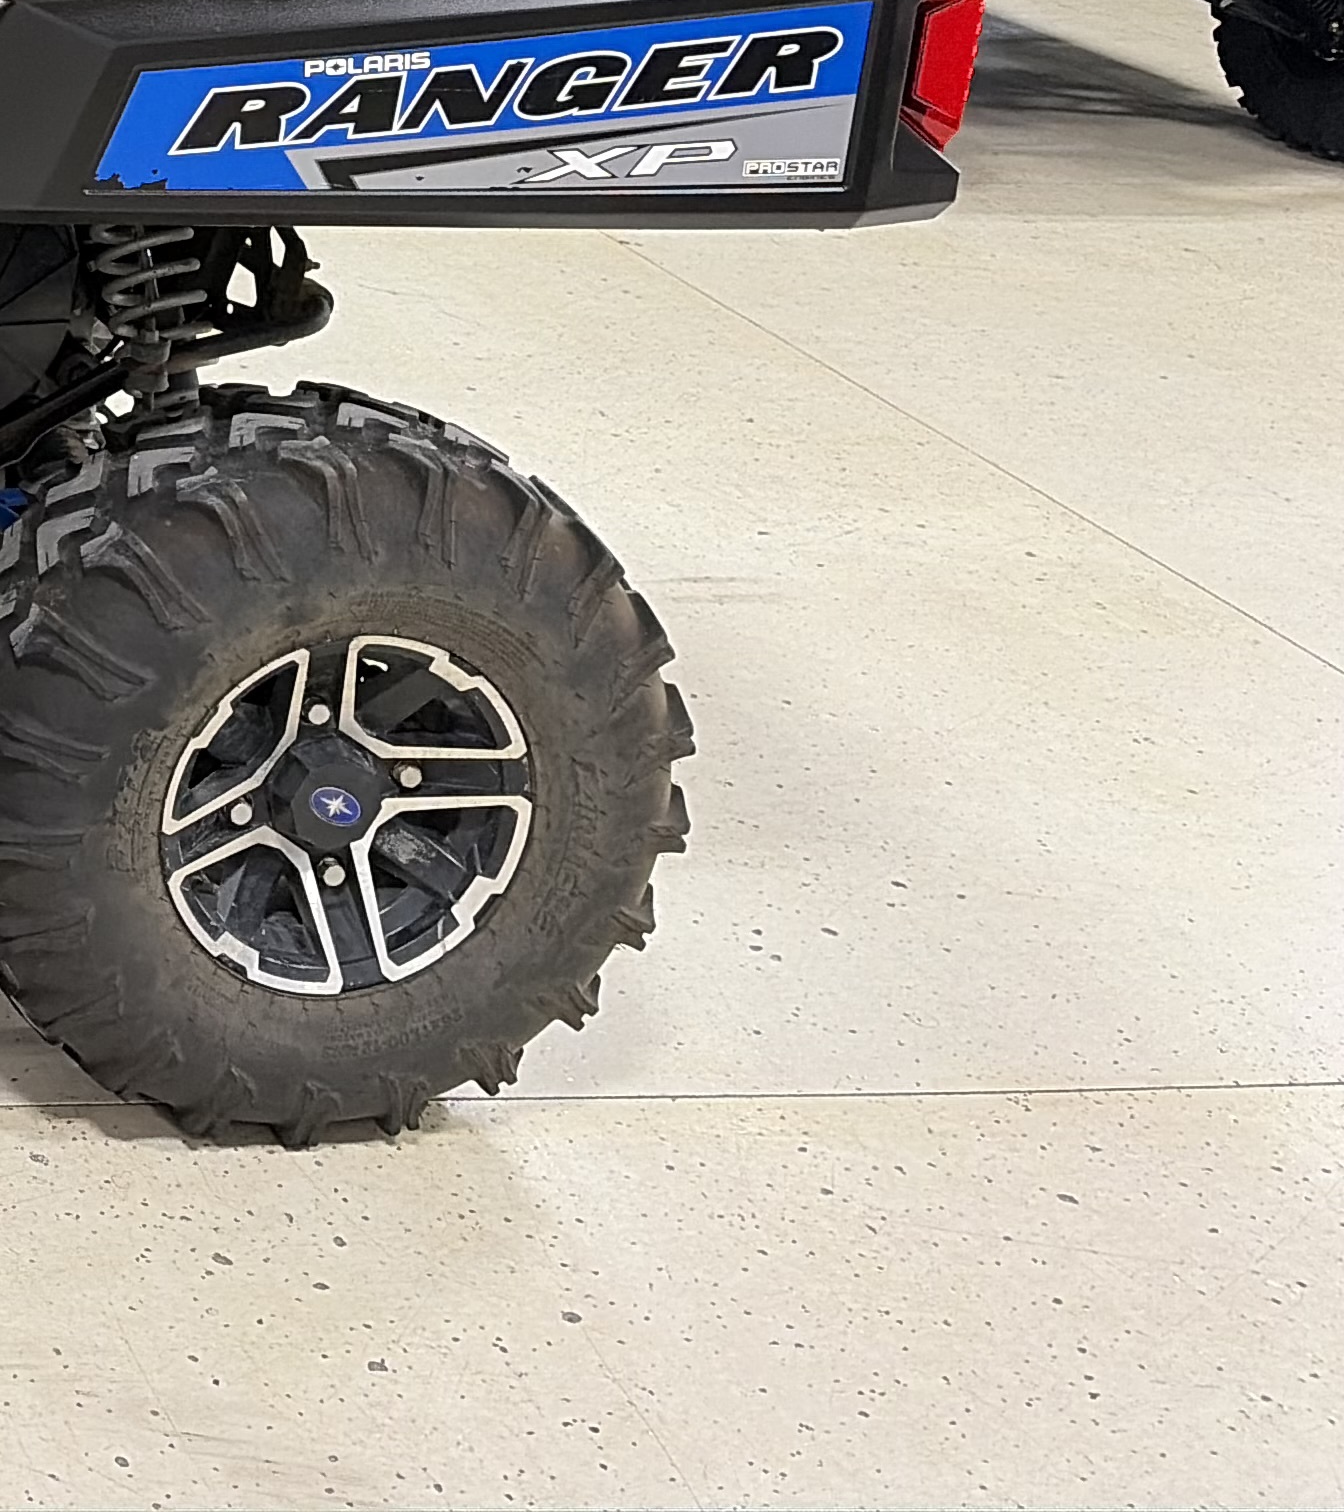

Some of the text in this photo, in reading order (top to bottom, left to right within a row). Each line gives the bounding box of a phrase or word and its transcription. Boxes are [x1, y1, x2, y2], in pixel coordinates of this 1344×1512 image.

[304, 51, 432, 78] POLARIS
[168, 25, 844, 157] RANGER
[510, 138, 739, 185] XP
[744, 159, 839, 175] PROSTAR
